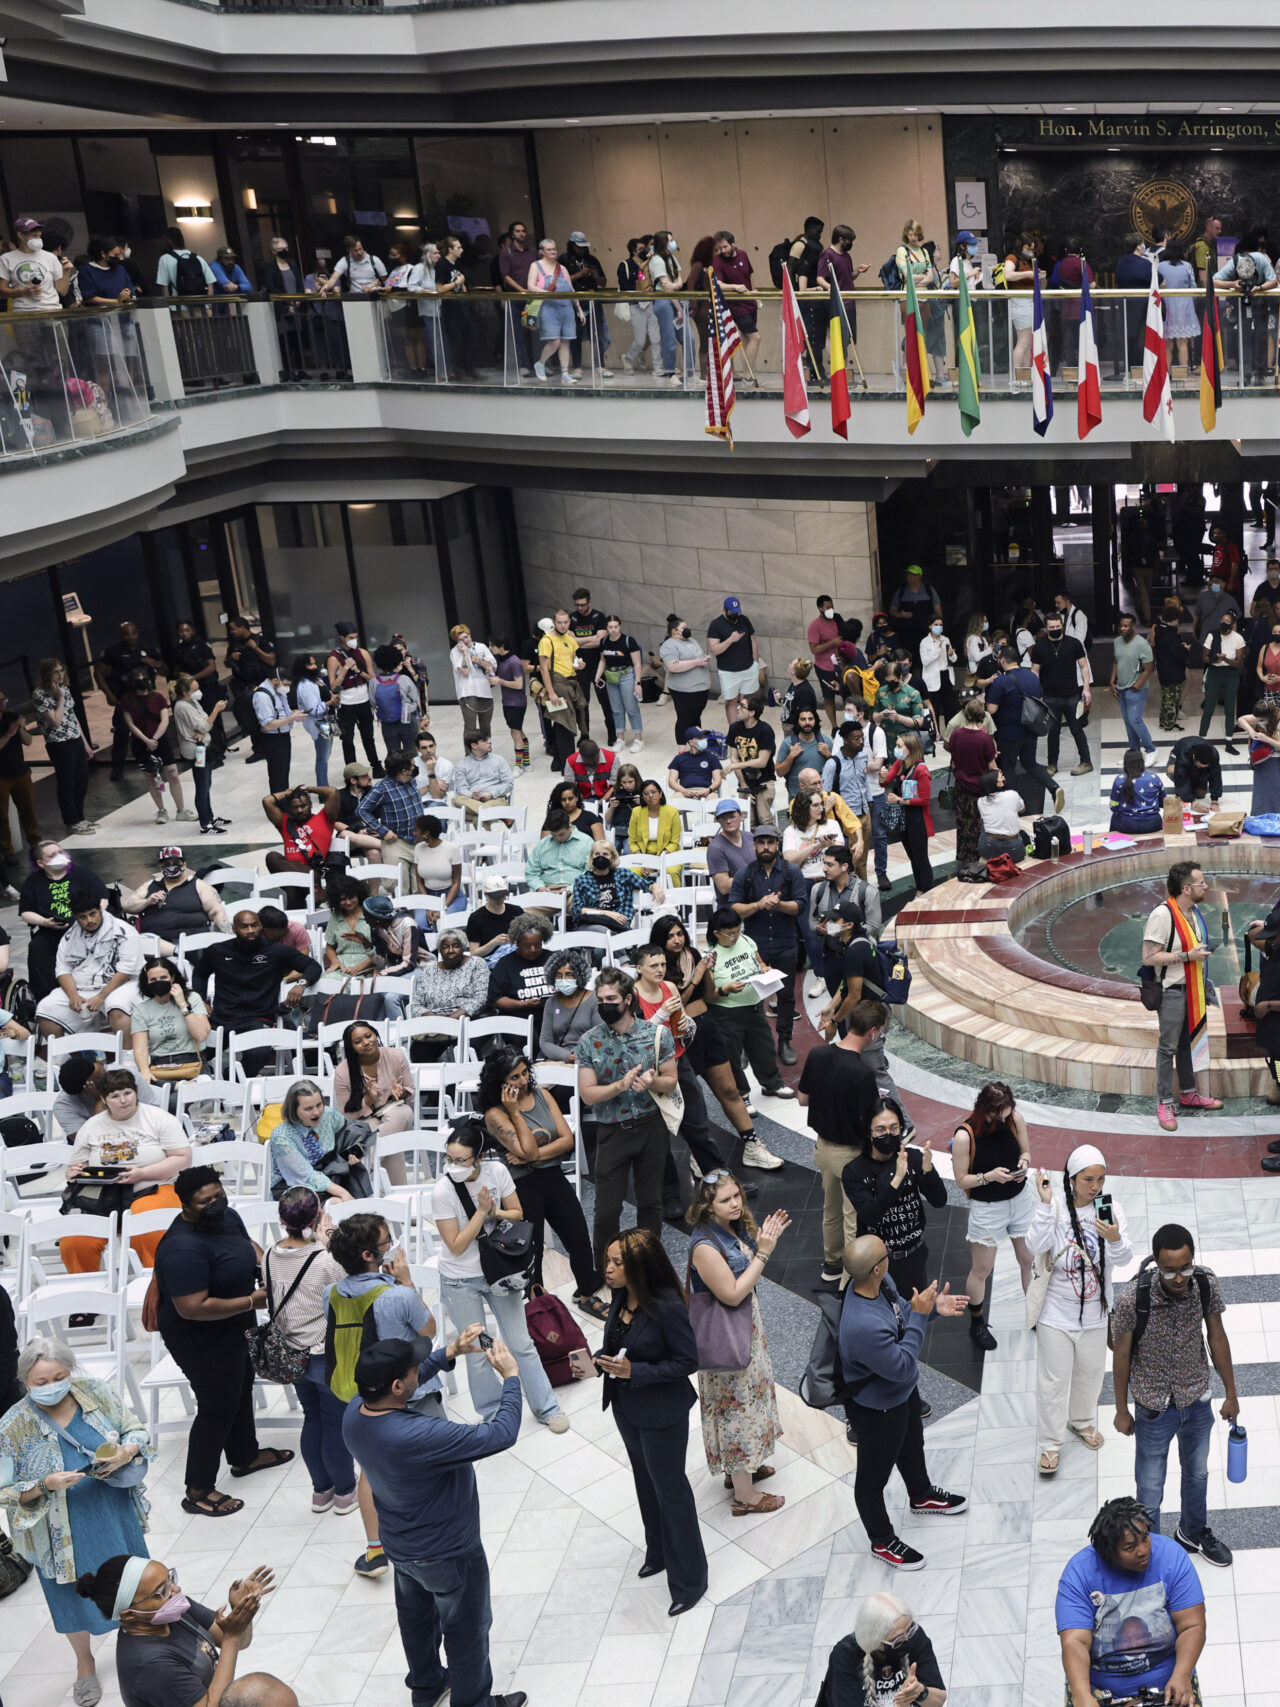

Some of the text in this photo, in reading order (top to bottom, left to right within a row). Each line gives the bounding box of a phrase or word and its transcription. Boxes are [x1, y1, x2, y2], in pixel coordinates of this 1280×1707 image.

[1040, 120, 1082, 136] Hon.
[1088, 120, 1151, 136] Marvin
[1157, 120, 1172, 136] S.
[1178, 120, 1269, 138] Arrington,
[725, 953, 749, 968] DEFUND
[731, 969, 746, 979] BUILD
